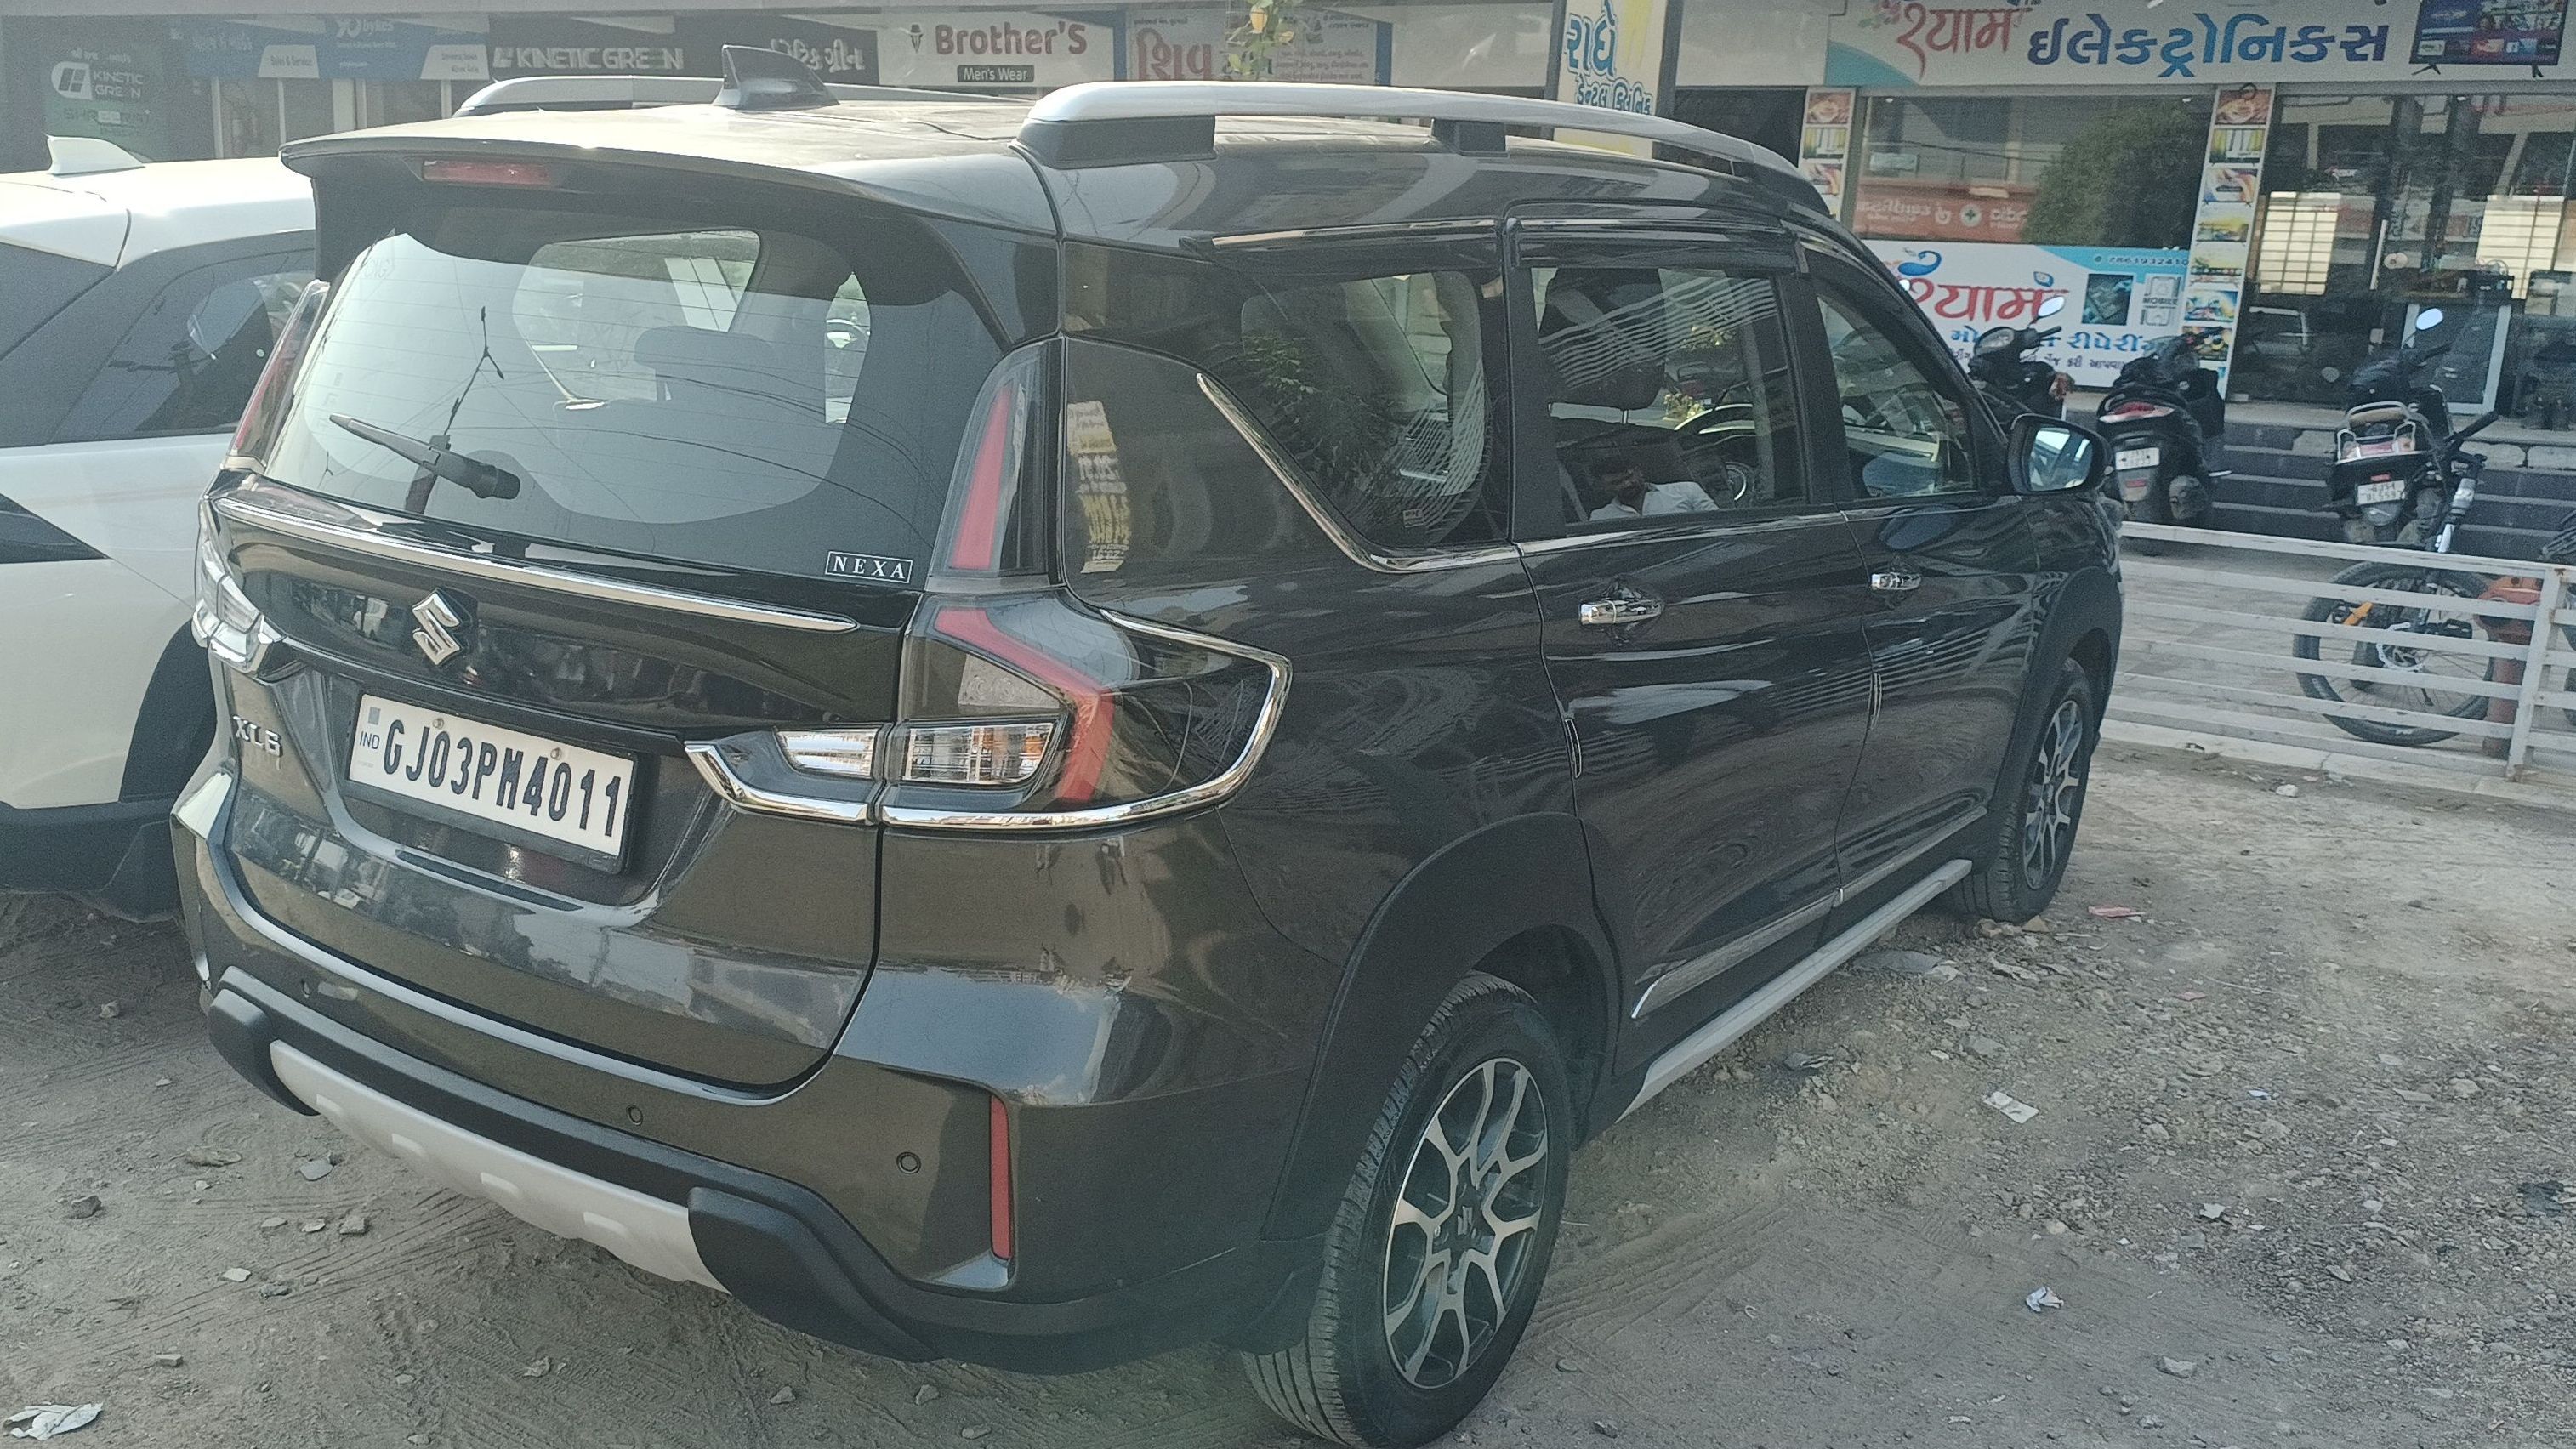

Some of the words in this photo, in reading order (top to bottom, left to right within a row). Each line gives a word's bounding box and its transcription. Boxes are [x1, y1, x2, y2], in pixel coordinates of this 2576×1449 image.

[935, 20, 1088, 55] Brother'S
[516, 47, 601, 70] KINETIC
[93, 70, 145, 84] KINETIC
[964, 67, 996, 81] Men's
[998, 67, 1027, 81] Wear
[94, 85, 141, 99] GREN
[833, 555, 906, 579] NEXA
[233, 715, 281, 757] XL6
[360, 731, 380, 750] IND
[384, 719, 622, 838] GJ03PM4011
